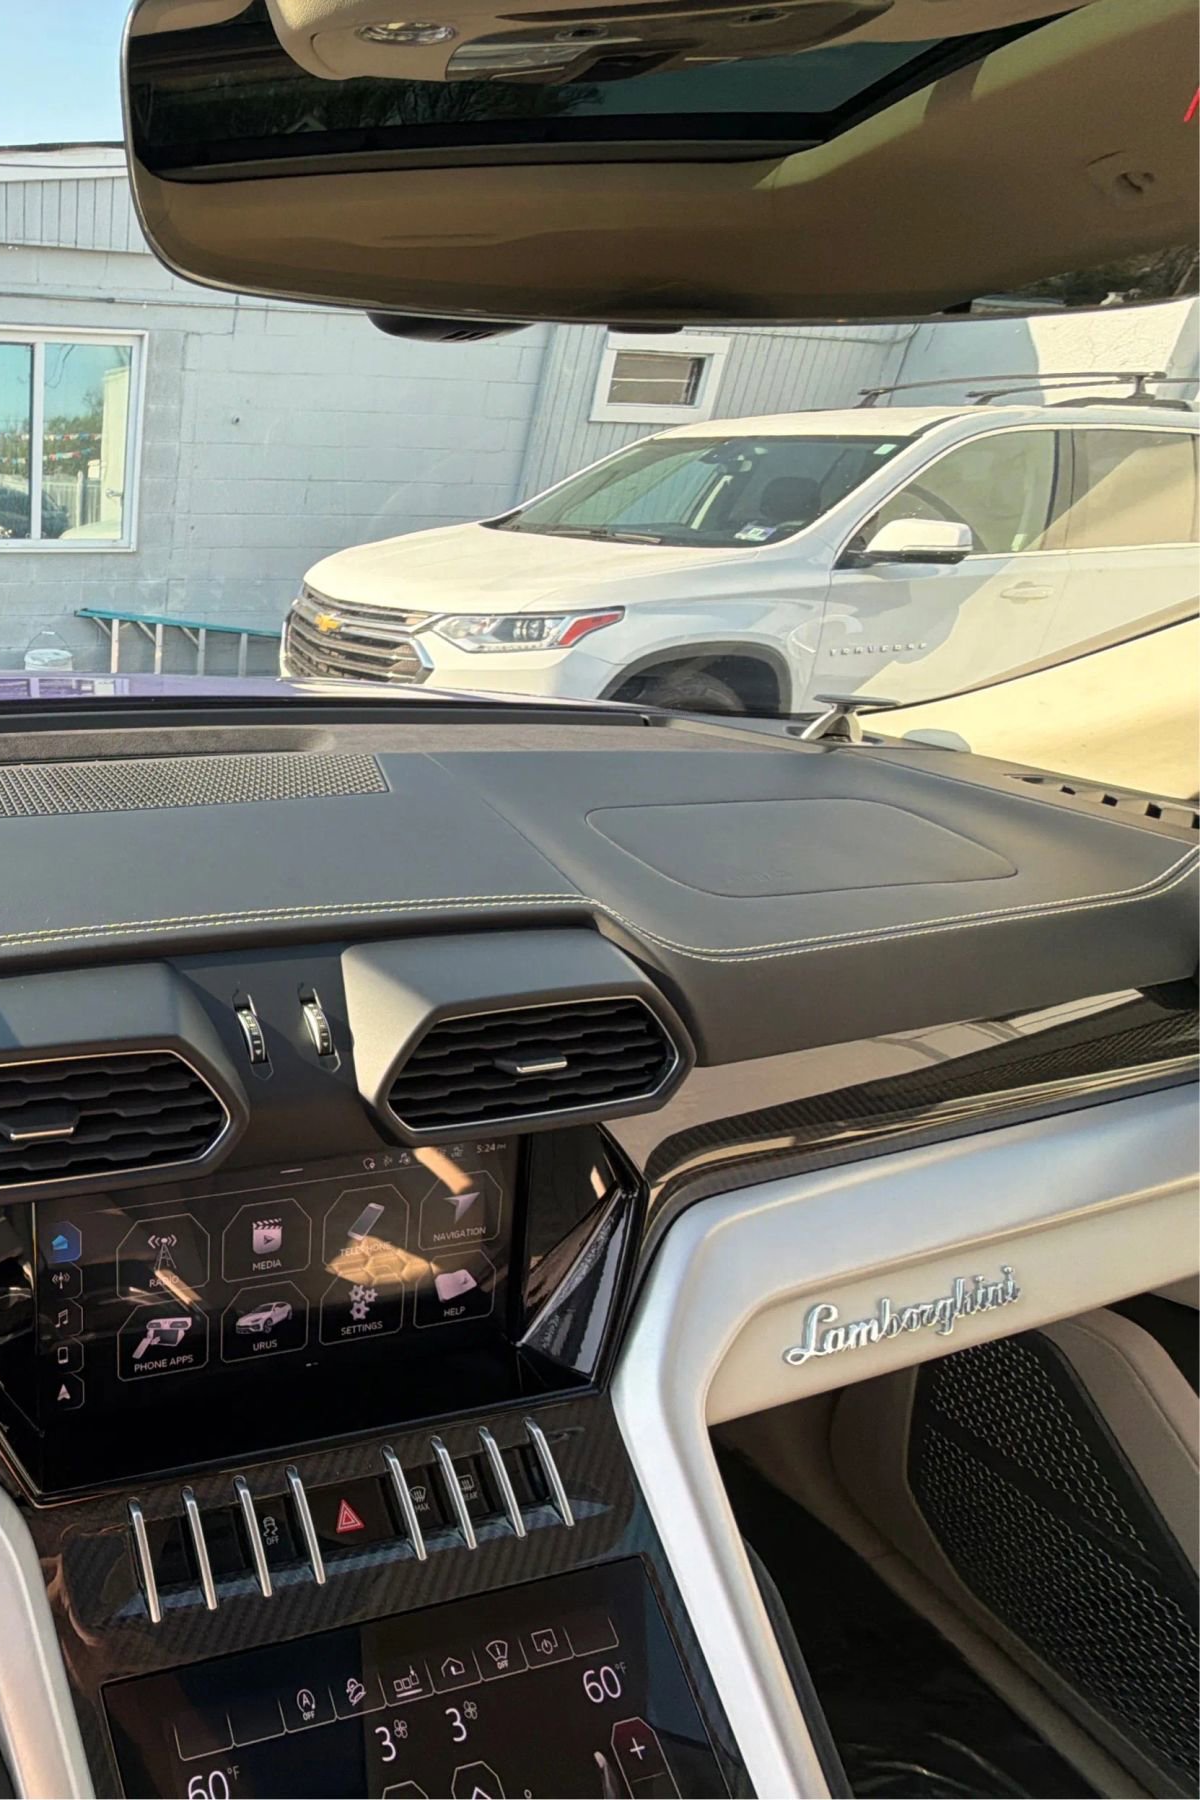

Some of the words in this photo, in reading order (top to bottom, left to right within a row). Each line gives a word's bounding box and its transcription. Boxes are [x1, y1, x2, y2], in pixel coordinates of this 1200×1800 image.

[476, 1142, 496, 1154] 5:24
[432, 1226, 487, 1242] NAVIGATION
[252, 1258, 282, 1272] MEDIA
[443, 1305, 466, 1317] HELP
[783, 1265, 1021, 1366] Lamborghini
[340, 1320, 383, 1336] SETTINGS
[252, 1338, 278, 1352] URUS
[134, 1357, 168, 1373] PHONE
[170, 1353, 194, 1367] APPS
[266, 1535, 280, 1546] OFF
[496, 1660, 509, 1670] OFF
[303, 1710, 315, 1721] OFF
[445, 1707, 468, 1742] 3
[374, 1726, 397, 1762] 3
